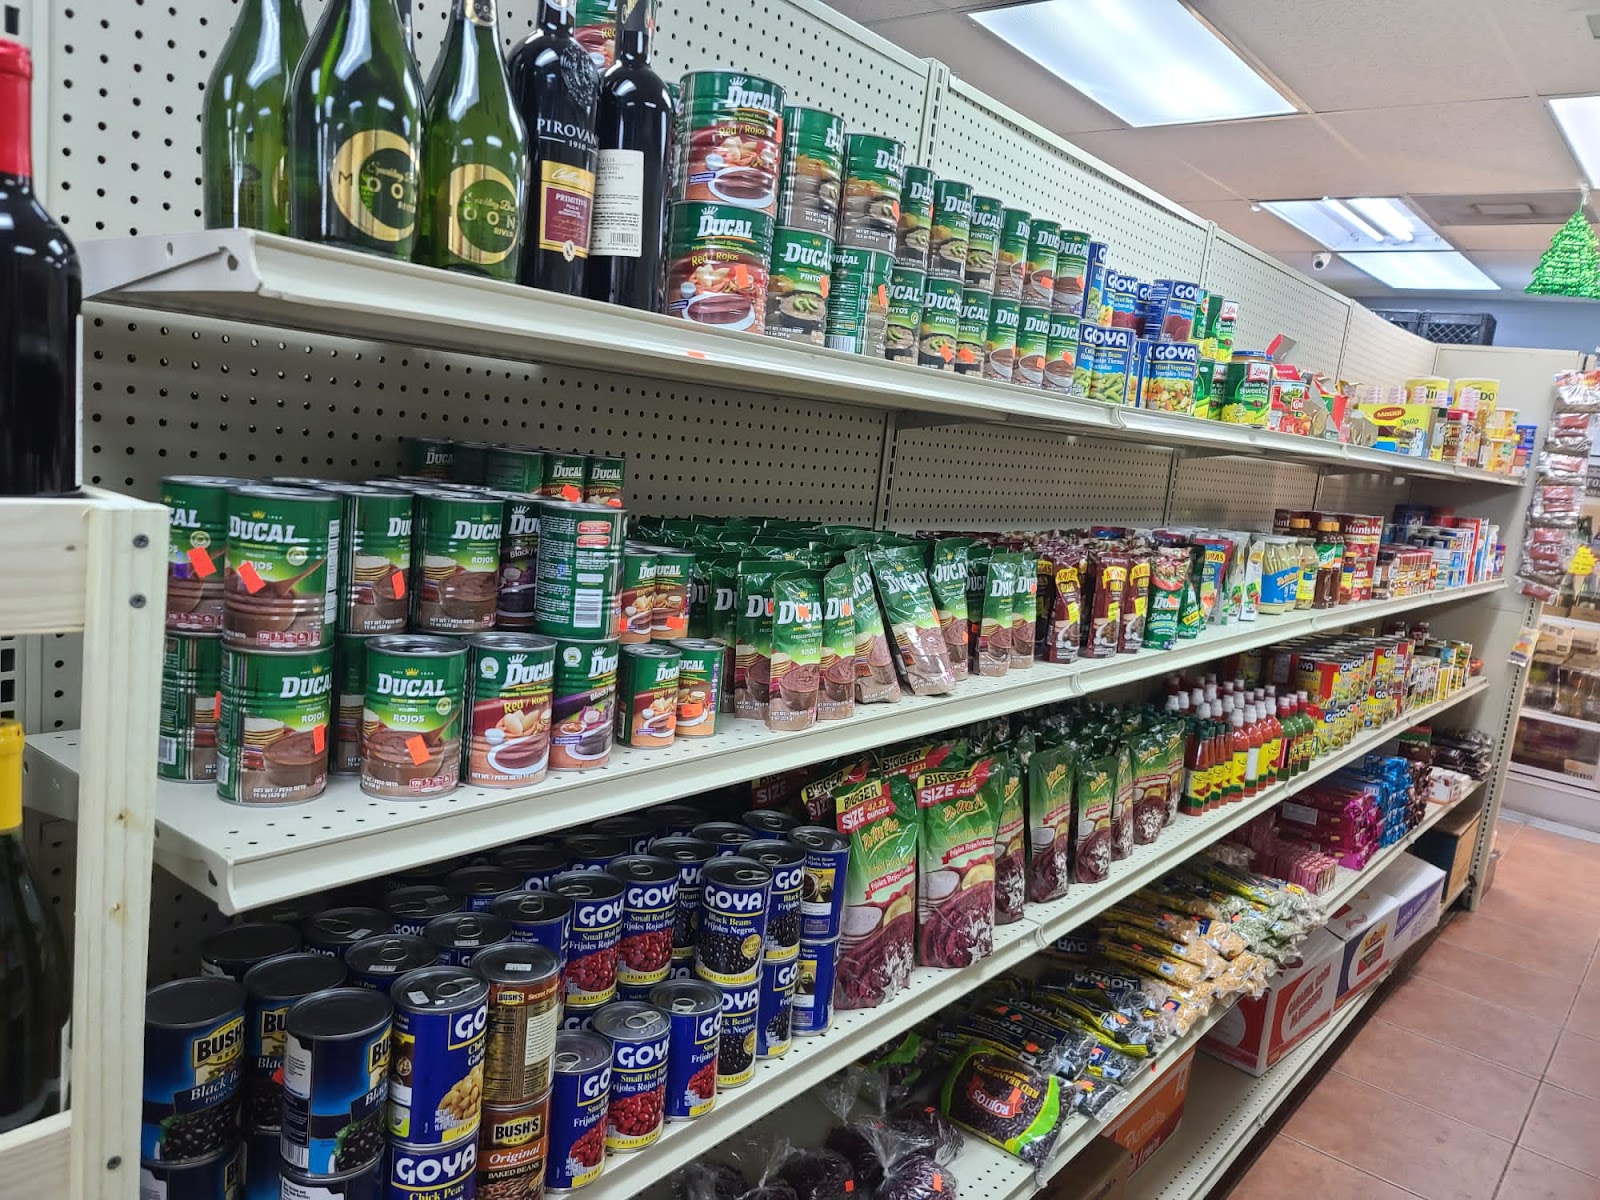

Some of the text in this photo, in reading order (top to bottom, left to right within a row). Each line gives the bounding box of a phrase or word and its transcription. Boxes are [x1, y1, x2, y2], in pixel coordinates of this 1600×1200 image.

[725, 86, 777, 112] DUCAL
[745, 125, 766, 136] Rojos
[697, 215, 753, 238] DUCAL
[692, 252, 739, 266] Red Rojos
[1156, 346, 1195, 360] GOYA
[553, 465, 583, 478] DUCAL
[591, 467, 621, 479] DUCAL
[229, 515, 298, 543] DUCAL
[471, 556, 493, 565] ROJOS
[377, 673, 446, 697] DUCAL
[504, 699, 523, 713] Red
[301, 711, 325, 723] ROJOS
[393, 714, 425, 724] ROJOS
[882, 749, 921, 771] BIGGER
[806, 770, 844, 799] BIGGER
[924, 770, 971, 787] BIGGER
[843, 783, 879, 810] BIGGER
[921, 783, 955, 804] SIZE
[841, 806, 865, 829] SIZE
[867, 805, 890, 820] ounces
[705, 885, 763, 911] GOYA
[630, 911, 664, 923] Small Red
[708, 912, 752, 926] Black Beans
[704, 918, 757, 936] Frijoles Negros
[582, 929, 616, 941] Small Red
[569, 941, 597, 951] Frijoles
[498, 993, 524, 1001] BUSH'S
[527, 990, 546, 1000] Secret
[732, 1017, 752, 1026] Beans
[691, 1049, 714, 1063] Frijoles
[620, 1071, 658, 1083] Small Red
[191, 1079, 227, 1101] Black
[1021, 1084, 1040, 1099] RED
[973, 1089, 1010, 1115] ROJITOS
[573, 1113, 600, 1127] Frijoles
[495, 1118, 539, 1141] BUSH'S
[489, 1144, 540, 1165] Original
[396, 1143, 476, 1185] GOYA
[488, 1162, 540, 1180] BAKED BEANS
[443, 1183, 465, 1199] Peas
